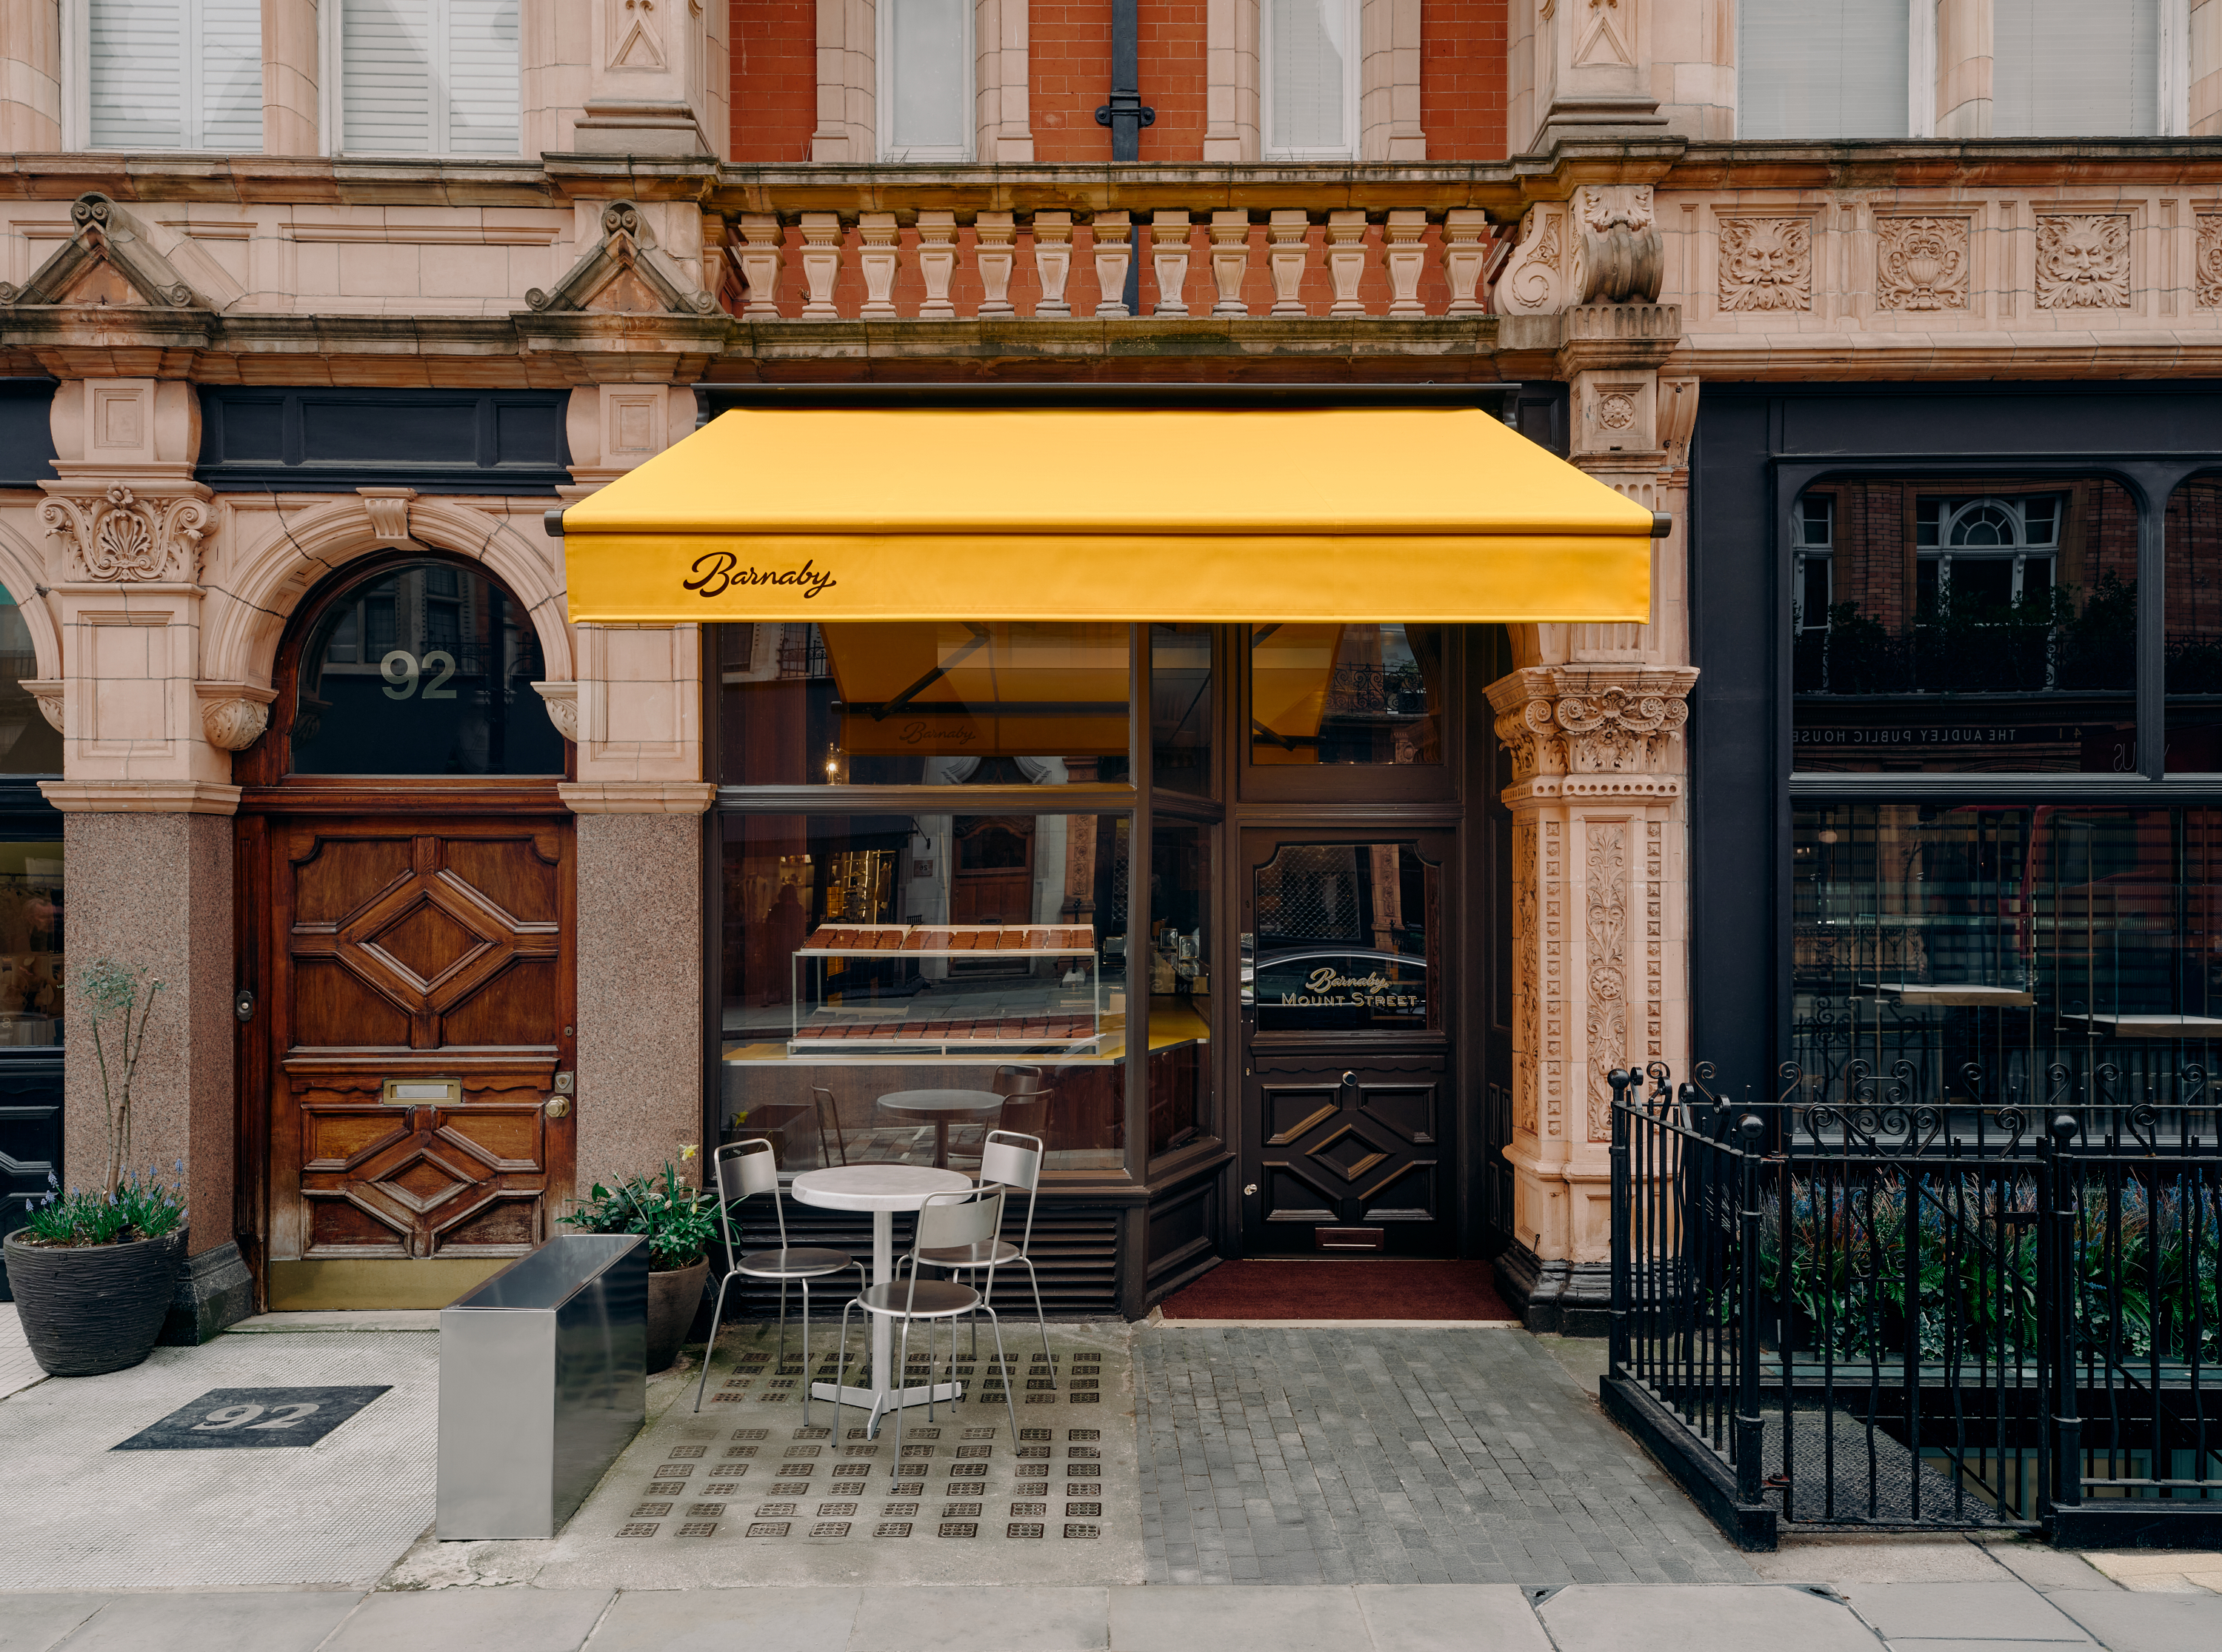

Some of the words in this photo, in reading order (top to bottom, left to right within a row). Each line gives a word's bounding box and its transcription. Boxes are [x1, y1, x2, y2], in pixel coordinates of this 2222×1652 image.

[683, 551, 837, 599] Barnaby
[380, 650, 457, 700] 92
[898, 721, 976, 745] Barnaby
[1305, 967, 1389, 994] Barnaby
[1281, 992, 1346, 1007] MOUNT
[1350, 991, 1418, 1007] STREET
[190, 1402, 320, 1431] 92
